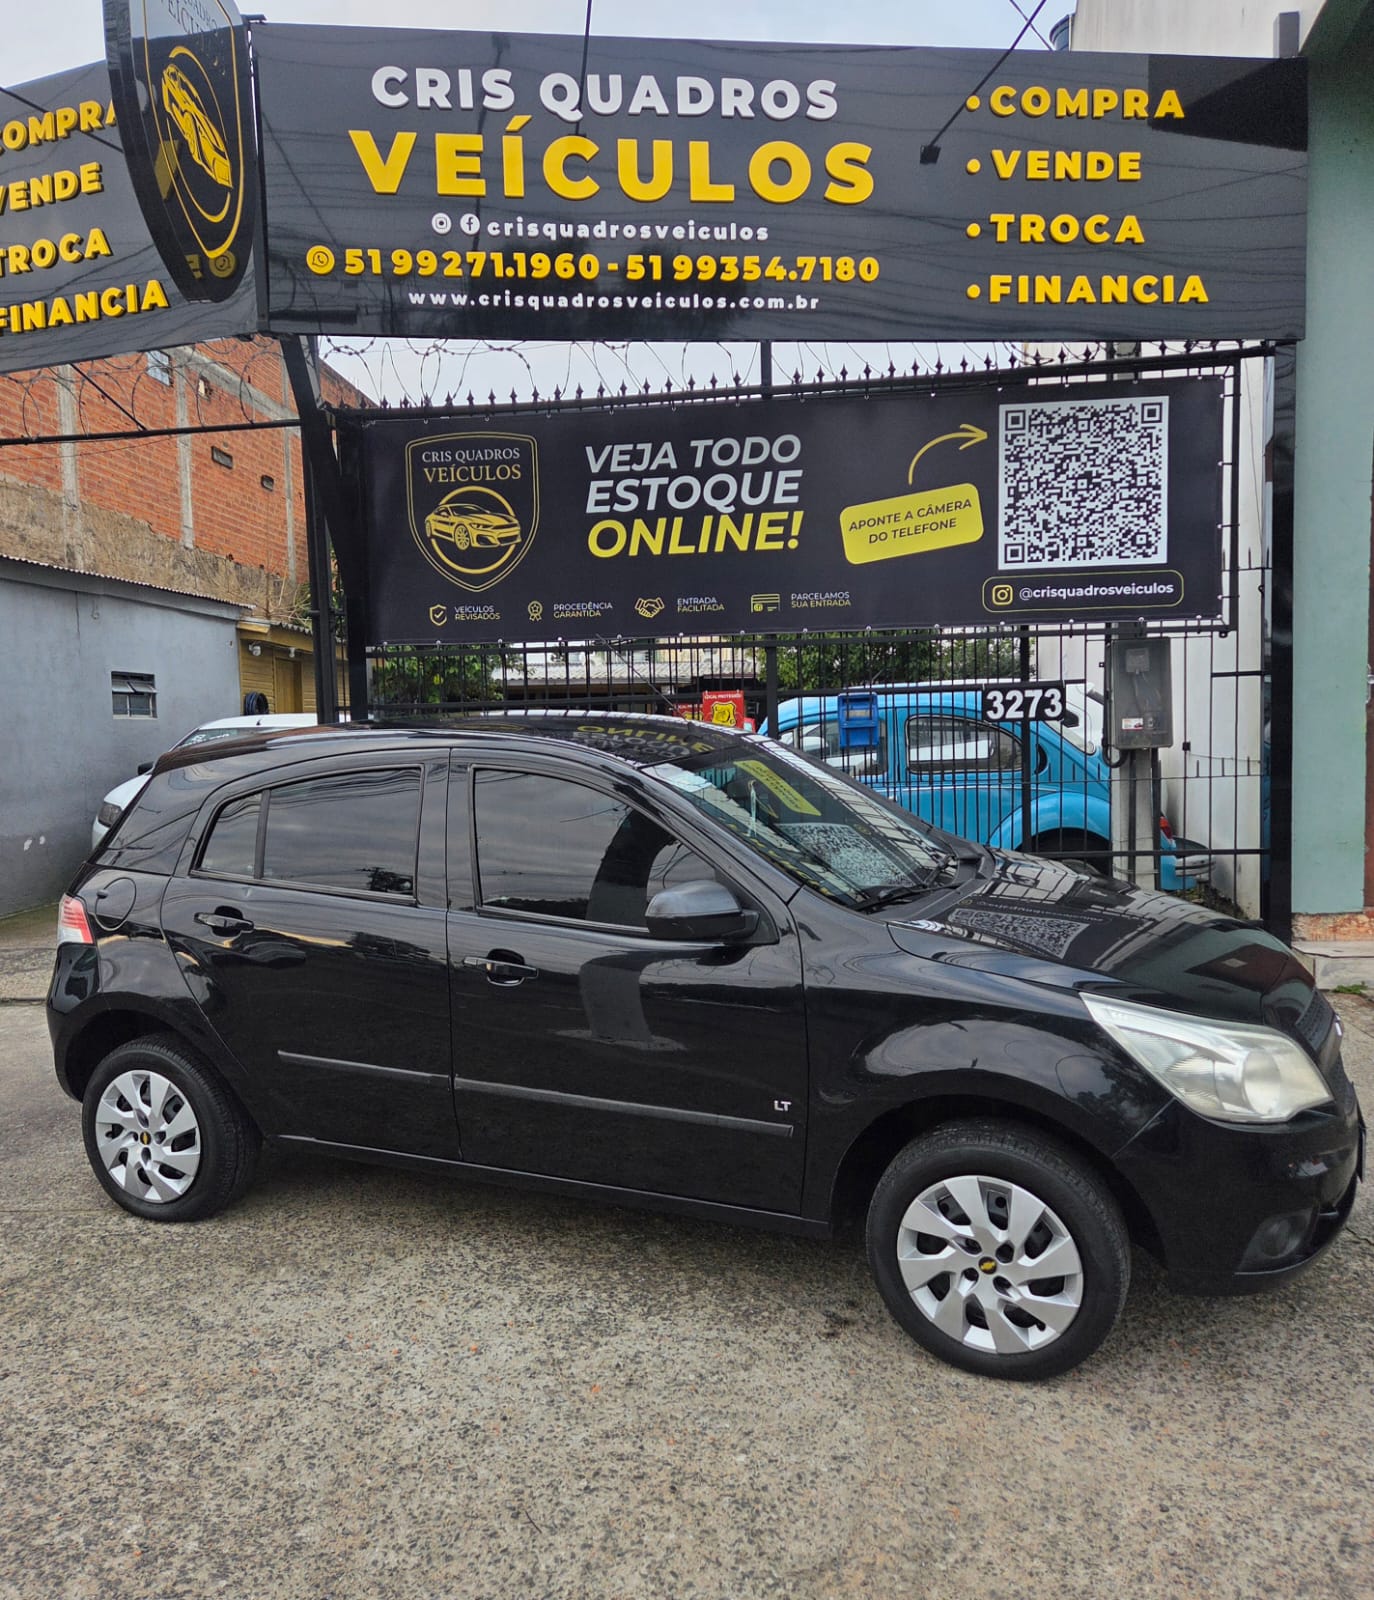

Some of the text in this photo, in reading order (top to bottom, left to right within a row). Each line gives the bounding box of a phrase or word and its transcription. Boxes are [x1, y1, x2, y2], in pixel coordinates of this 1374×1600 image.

[371, 66, 838, 122] CRIS QUADROS
[990, 86, 1185, 119] COMPRA
[0, 99, 117, 154] OMPR
[348, 115, 874, 204] VEÍCULOS
[991, 149, 1142, 180] VENDE
[487, 216, 769, 240] crisquadrosveiculos
[989, 213, 1145, 243] TROCA
[345, 249, 382, 275] 51
[391, 249, 601, 279] 99271.1960
[626, 255, 663, 281] 51
[672, 255, 880, 282] 99354.7180
[408, 290, 819, 310] www.crisquadrosveiculos.com.br
[989, 275, 1209, 304] FINANCIA
[422, 448, 520, 463] CRIS QUADROS
[585, 434, 802, 474] VEJA TODO
[423, 464, 522, 483] VEÍCULOS
[585, 469, 803, 513] ESTOQUE
[849, 499, 972, 531] APONTE A CÂMERA
[587, 511, 804, 558] ONLINE!
[868, 518, 957, 544] DO TELEFONE
[677, 597, 717, 605] ENTRADA
[791, 592, 850, 601] PARCELAMOS
[1019, 582, 1175, 600] @crisquadrosveiculos
[454, 605, 494, 613] VEÍCULOS
[553, 601, 613, 611] PROCEDÊNCIA
[553, 610, 601, 619] GARANTIDA
[677, 604, 725, 613] FACILITADA
[791, 599, 851, 609] SUA ENTRADA
[454, 613, 501, 621] REVISADOS
[986, 688, 1063, 720] 3273
[774, 1100, 792, 1111] LT
